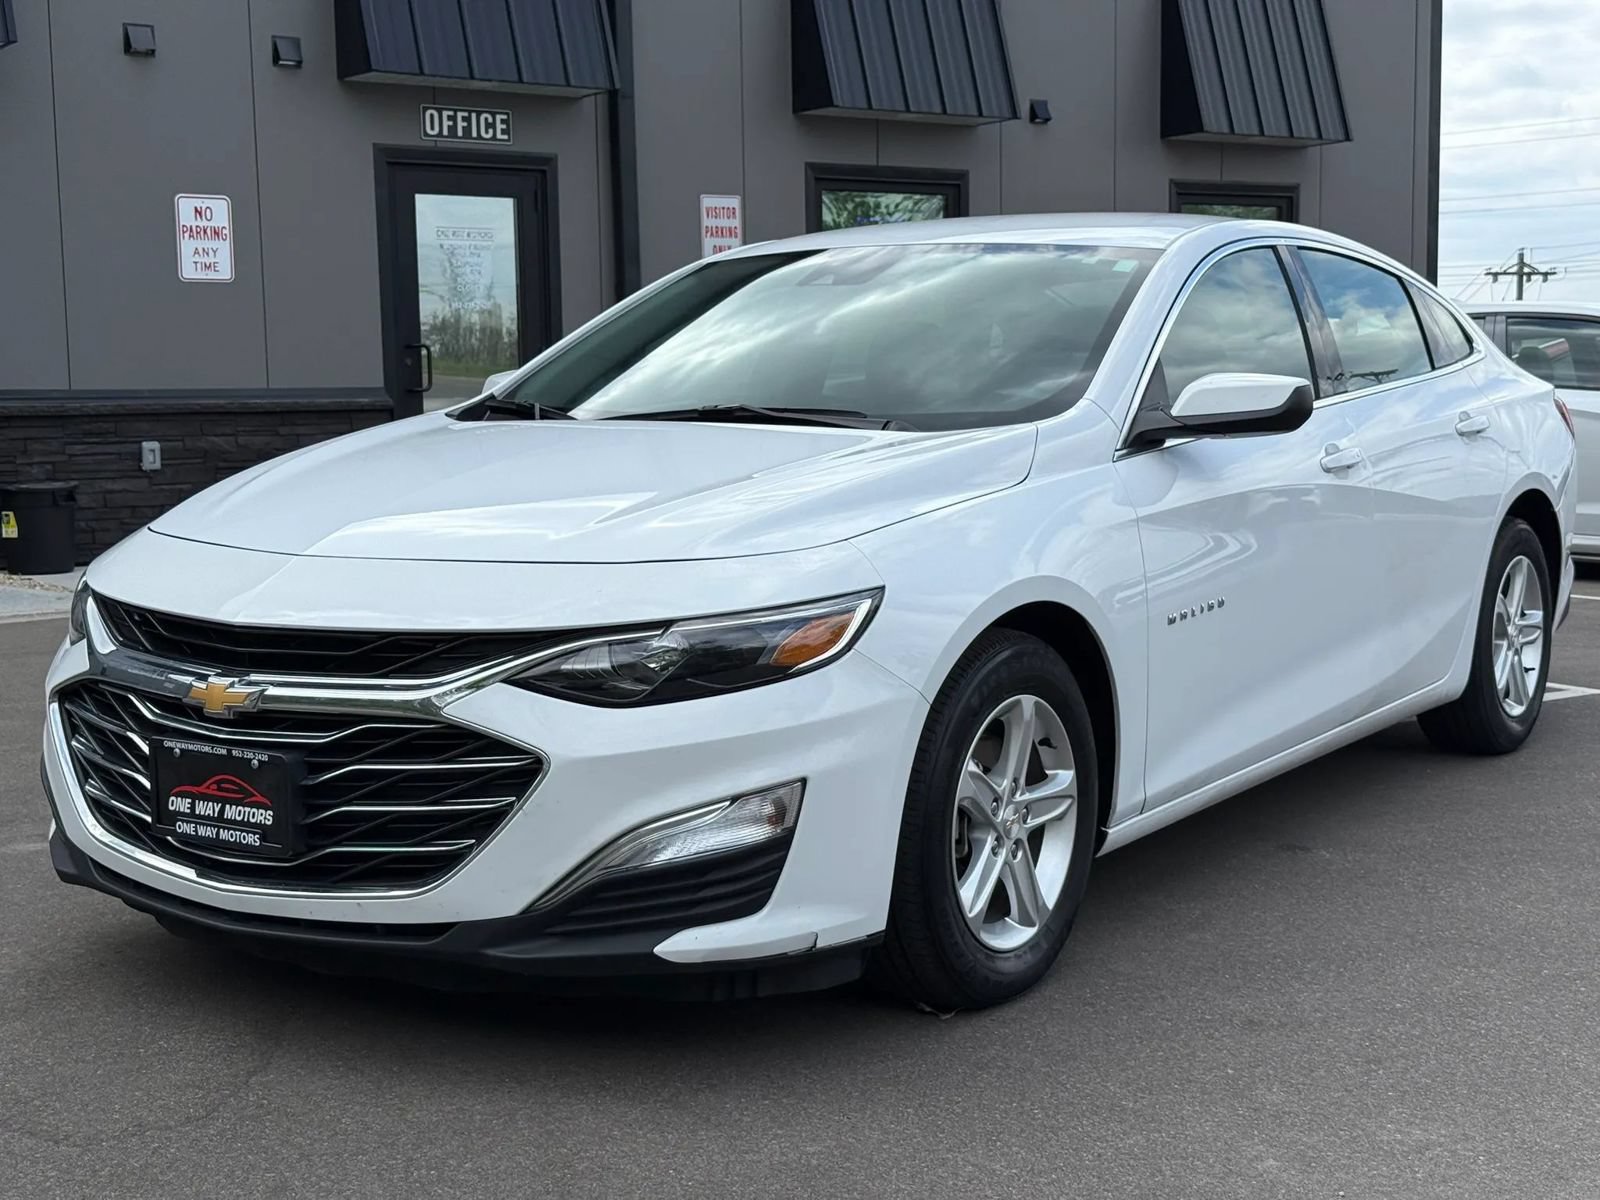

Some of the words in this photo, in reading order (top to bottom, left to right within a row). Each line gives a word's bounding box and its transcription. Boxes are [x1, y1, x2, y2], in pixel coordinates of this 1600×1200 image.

[425, 109, 509, 139] OFFICE
[194, 206, 213, 222] NO
[704, 206, 737, 220] VISITOR
[181, 224, 228, 242] PARKING
[704, 225, 739, 239] PARKING
[192, 247, 219, 258] ANY
[193, 261, 220, 273] TIME
[163, 740, 228, 755] ONEWAYMOTORS.COM
[168, 796, 192, 813] ONE
[195, 800, 222, 818] WAY
[224, 804, 274, 825] MOTORS
[176, 821, 196, 835] ONE
[197, 824, 218, 839] WAY
[219, 828, 261, 846] MOTORS
